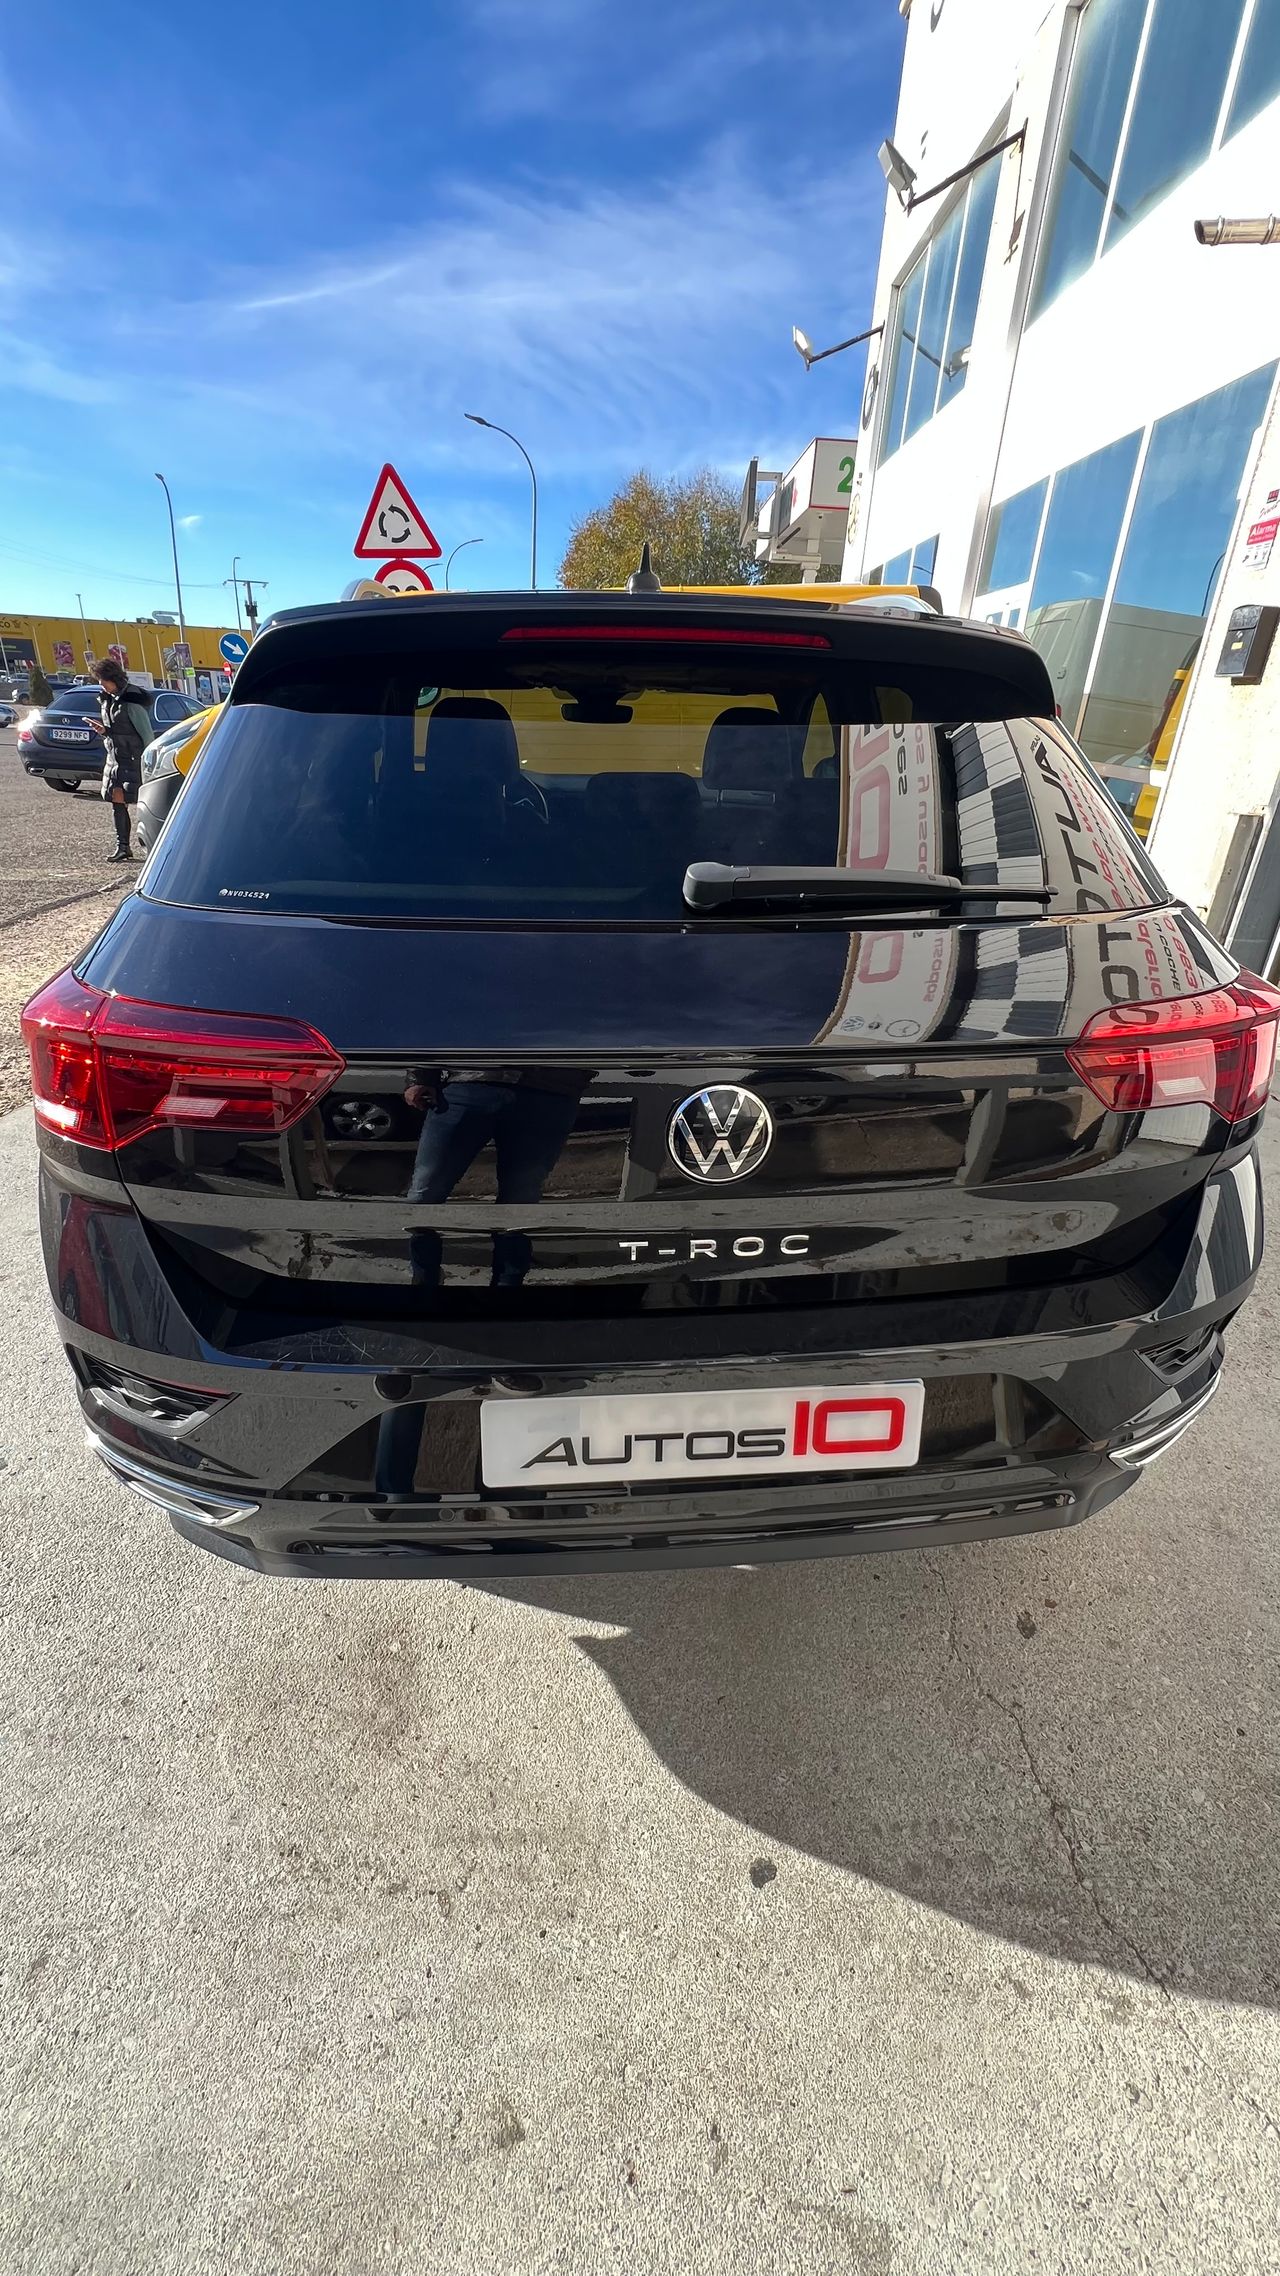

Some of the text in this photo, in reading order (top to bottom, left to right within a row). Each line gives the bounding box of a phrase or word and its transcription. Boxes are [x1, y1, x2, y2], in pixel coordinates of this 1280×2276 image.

[53, 730, 88, 740] 9299 NFC
[619, 1235, 810, 1261] T-ROC
